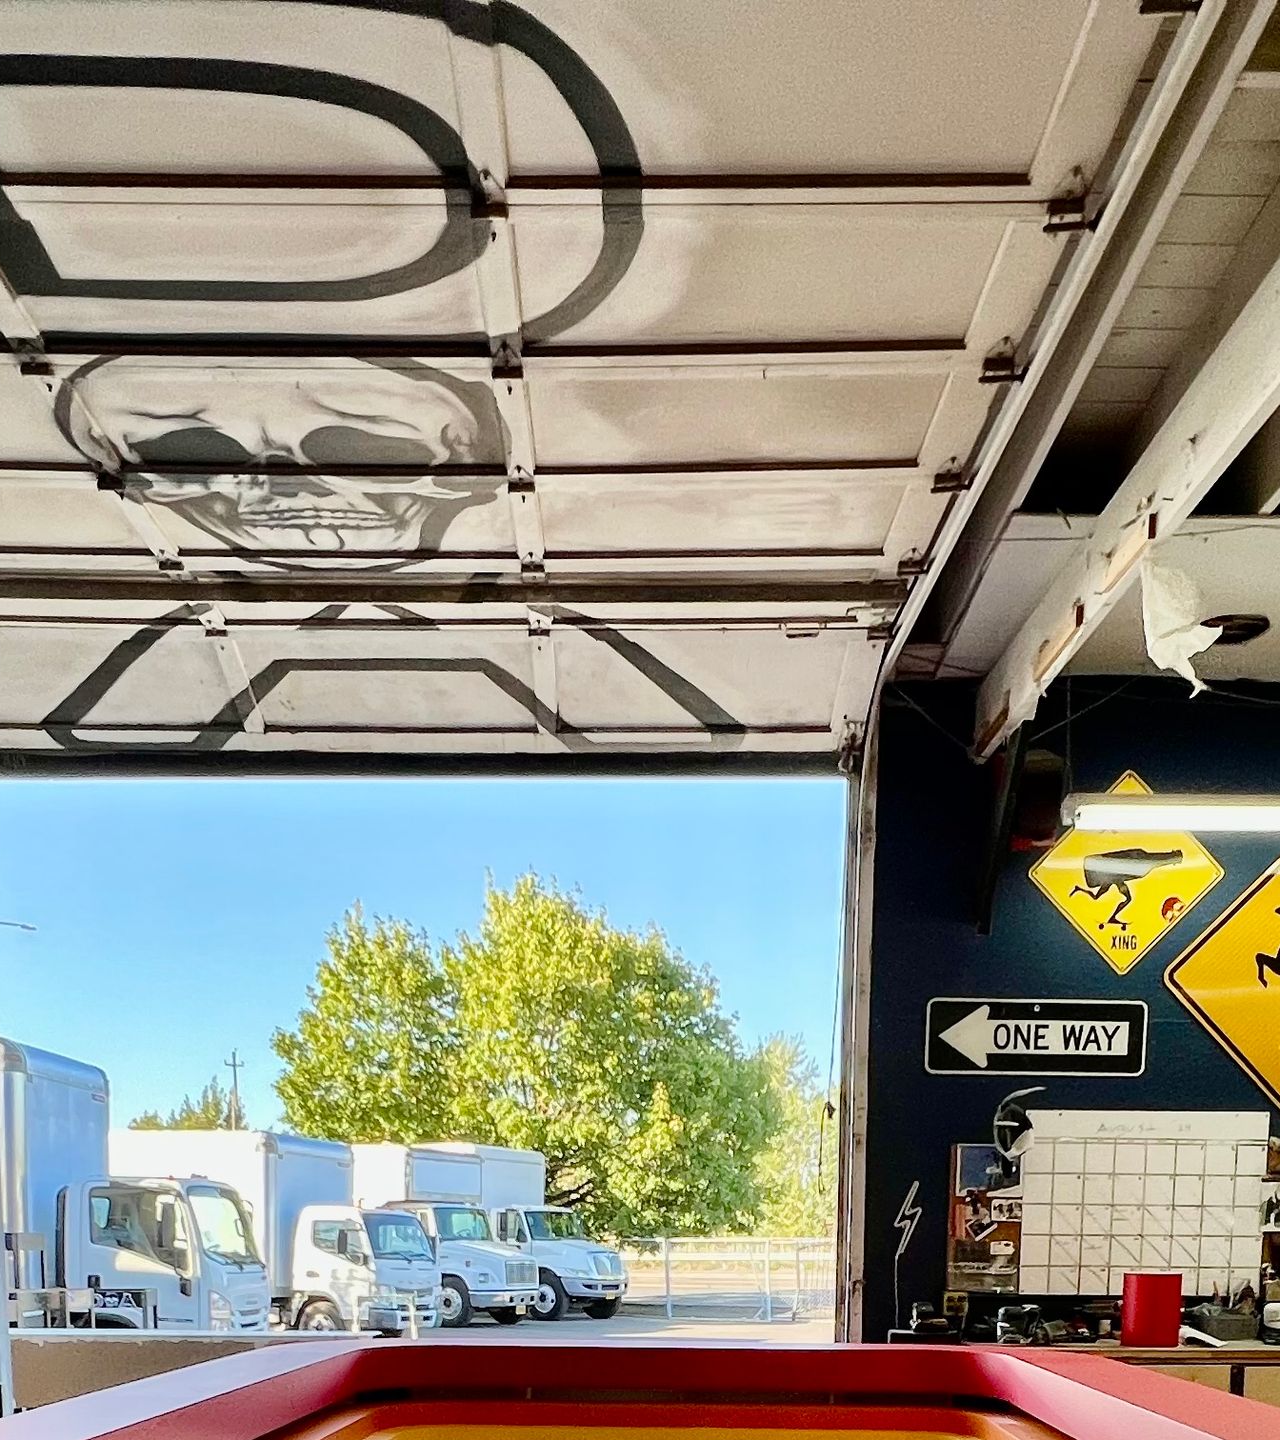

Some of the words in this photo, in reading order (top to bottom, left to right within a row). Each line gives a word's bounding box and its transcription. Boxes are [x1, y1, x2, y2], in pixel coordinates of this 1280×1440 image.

[1111, 935, 1138, 950] XING
[993, 1023, 1050, 1051] ONE
[1062, 1024, 1121, 1052] WAY
